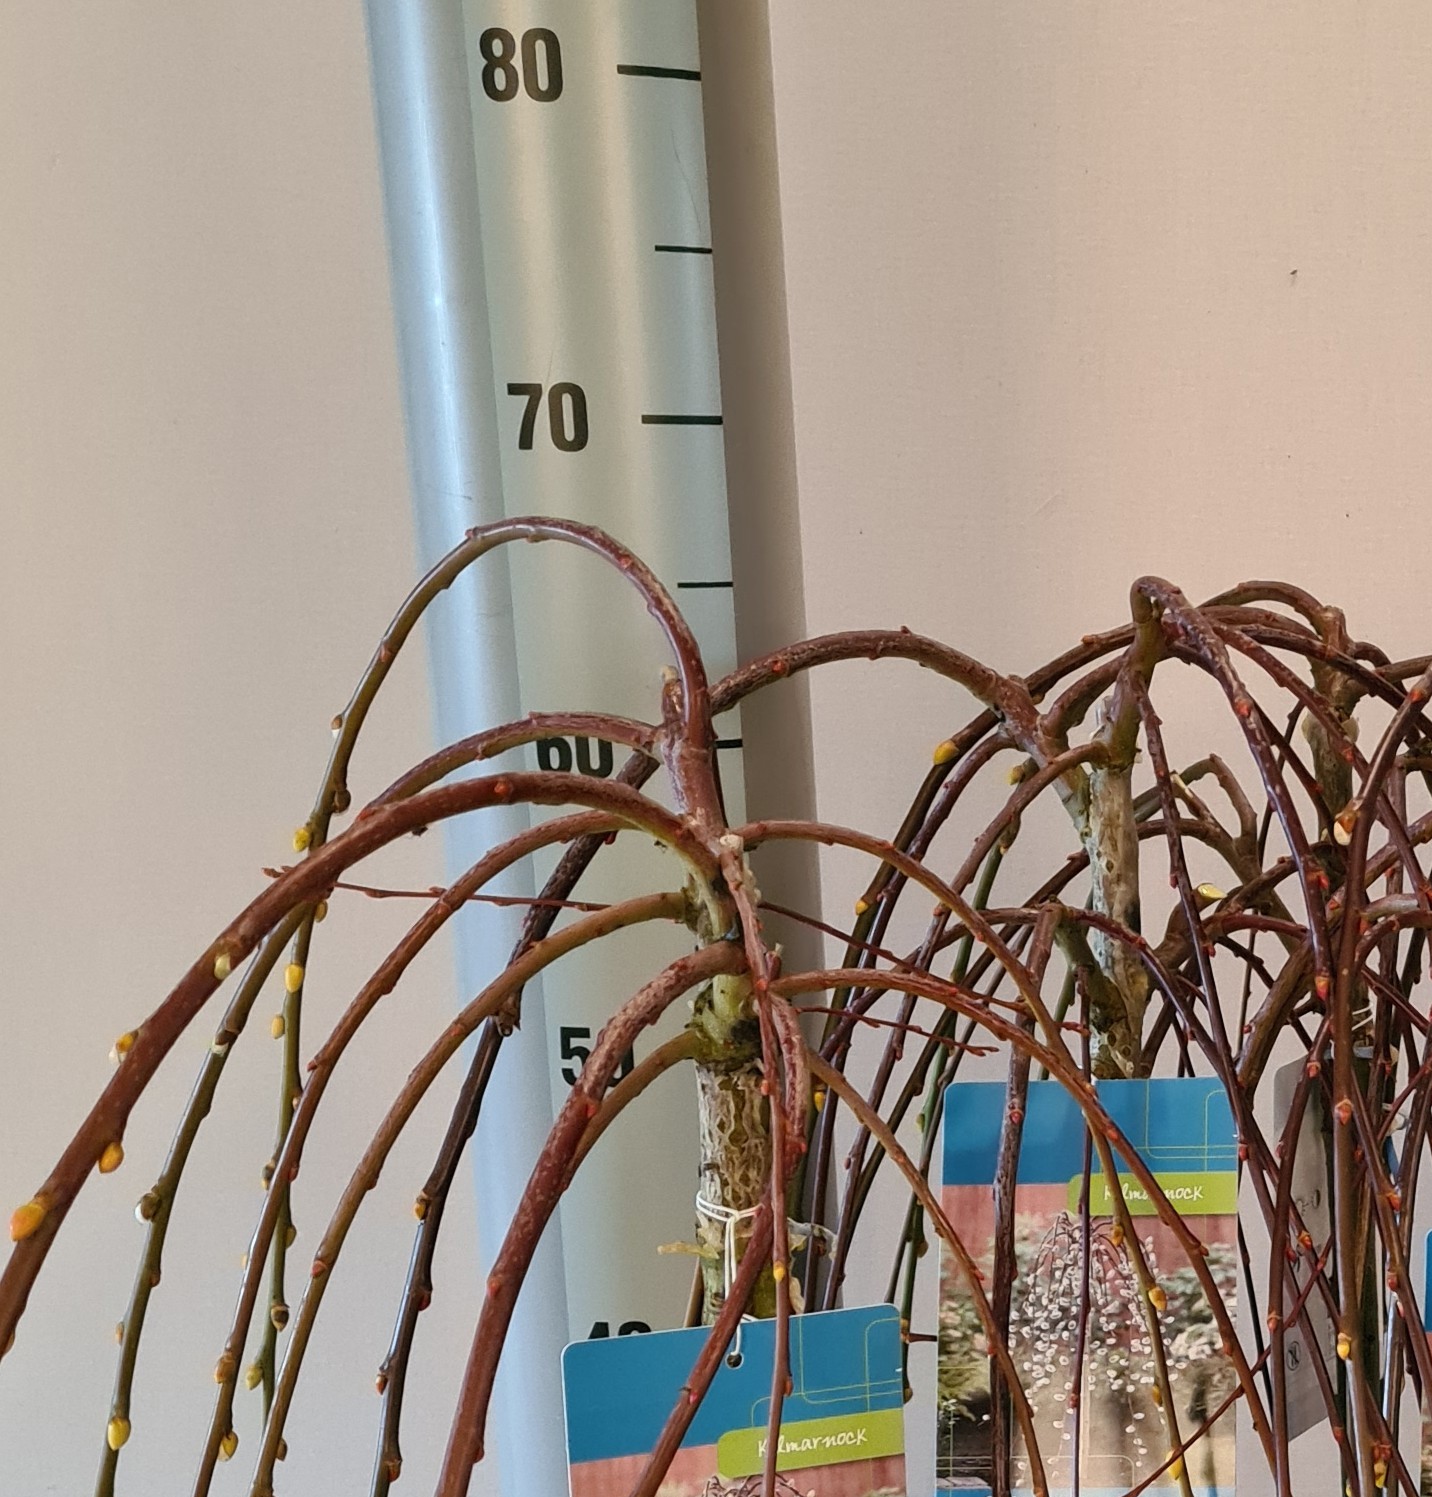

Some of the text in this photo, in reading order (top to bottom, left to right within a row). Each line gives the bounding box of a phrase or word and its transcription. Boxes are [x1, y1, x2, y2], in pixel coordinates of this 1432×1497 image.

[479, 27, 563, 102] 80
[507, 382, 589, 452] 70
[536, 735, 614, 778] 60
[758, 1427, 868, 1457] Klmarnock
